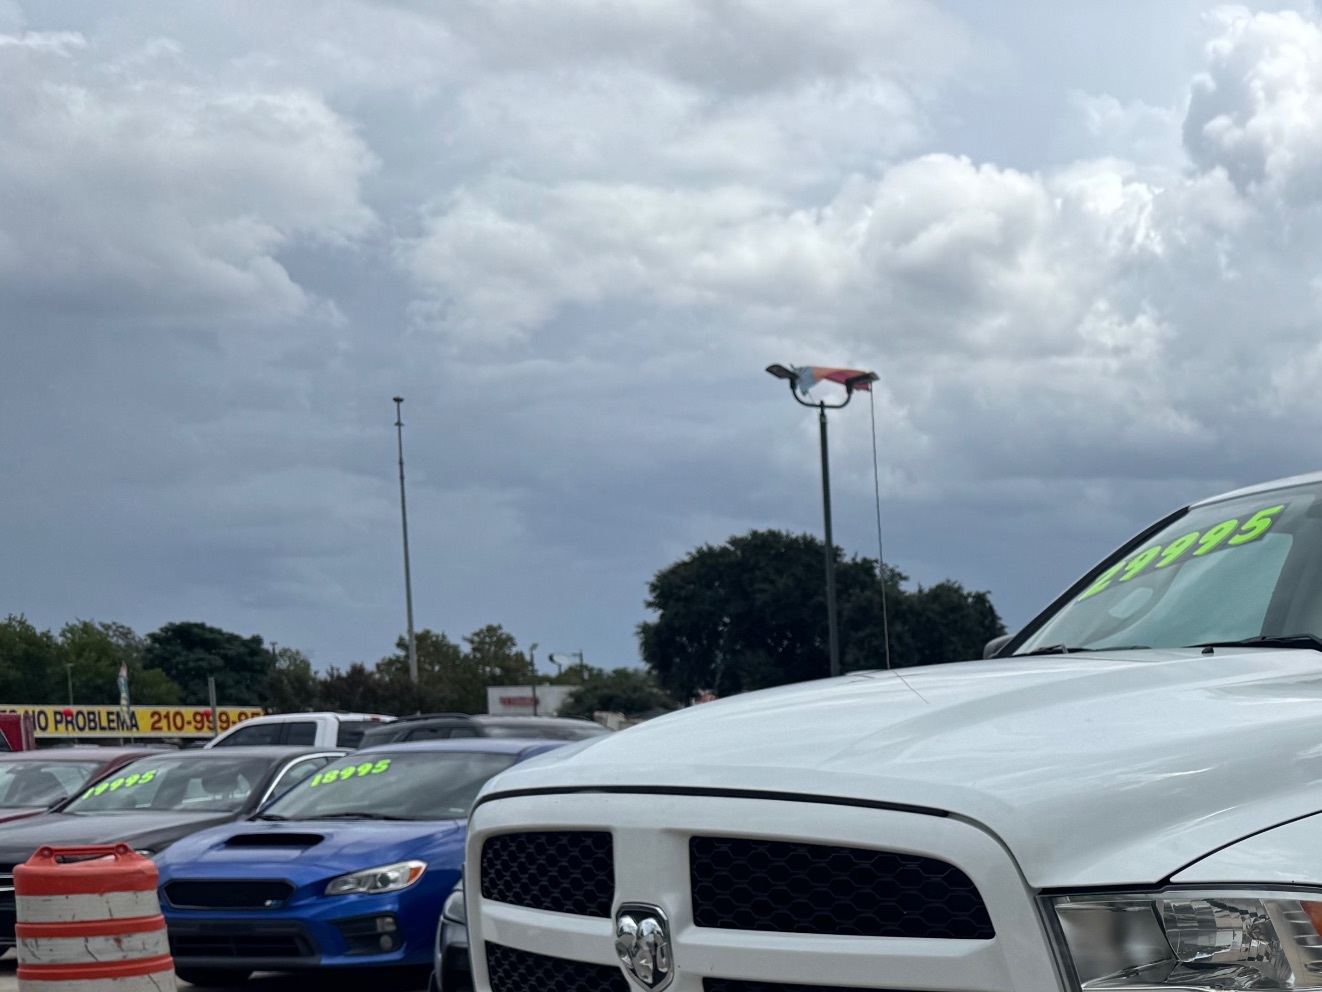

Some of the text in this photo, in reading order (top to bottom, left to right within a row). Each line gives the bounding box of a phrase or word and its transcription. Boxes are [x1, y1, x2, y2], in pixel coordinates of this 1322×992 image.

[1078, 504, 1285, 602] 29995
[53, 709, 140, 731] PROBLEMA
[310, 759, 392, 788] 18995
